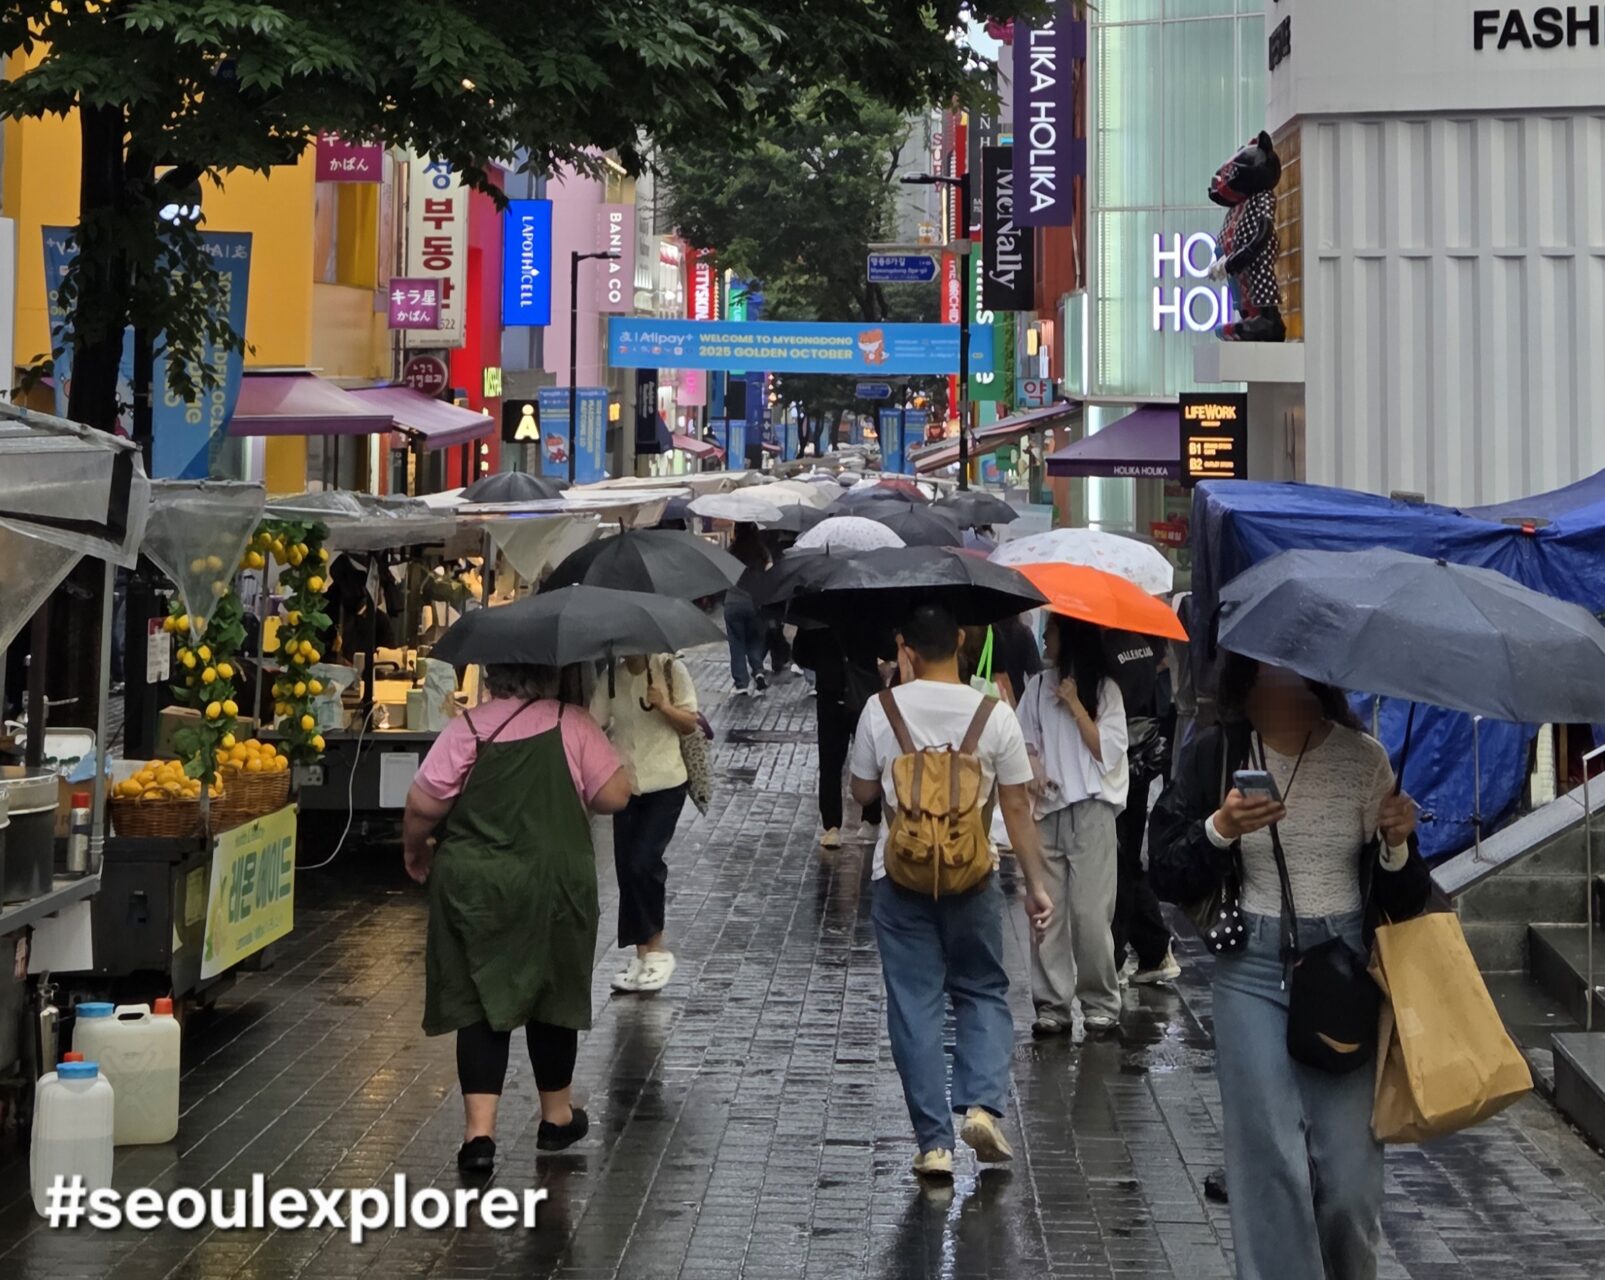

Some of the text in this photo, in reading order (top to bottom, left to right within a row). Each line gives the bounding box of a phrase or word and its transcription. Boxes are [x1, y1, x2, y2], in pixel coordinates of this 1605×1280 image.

[1029, 101, 1057, 214] HOLIKA
[608, 212, 622, 303] BANIA CO
[391, 289, 437, 306] キラ星
[699, 333, 853, 346] WELCOME TO MYEONGDONG
[699, 345, 853, 360] 2025 GOLDEN OCTOBER
[1024, 380, 1047, 405] 약
[1189, 442, 1201, 455] B1
[1113, 466, 1168, 476] HOLIKA HOLIKA
[1189, 457, 1203, 470] B2
